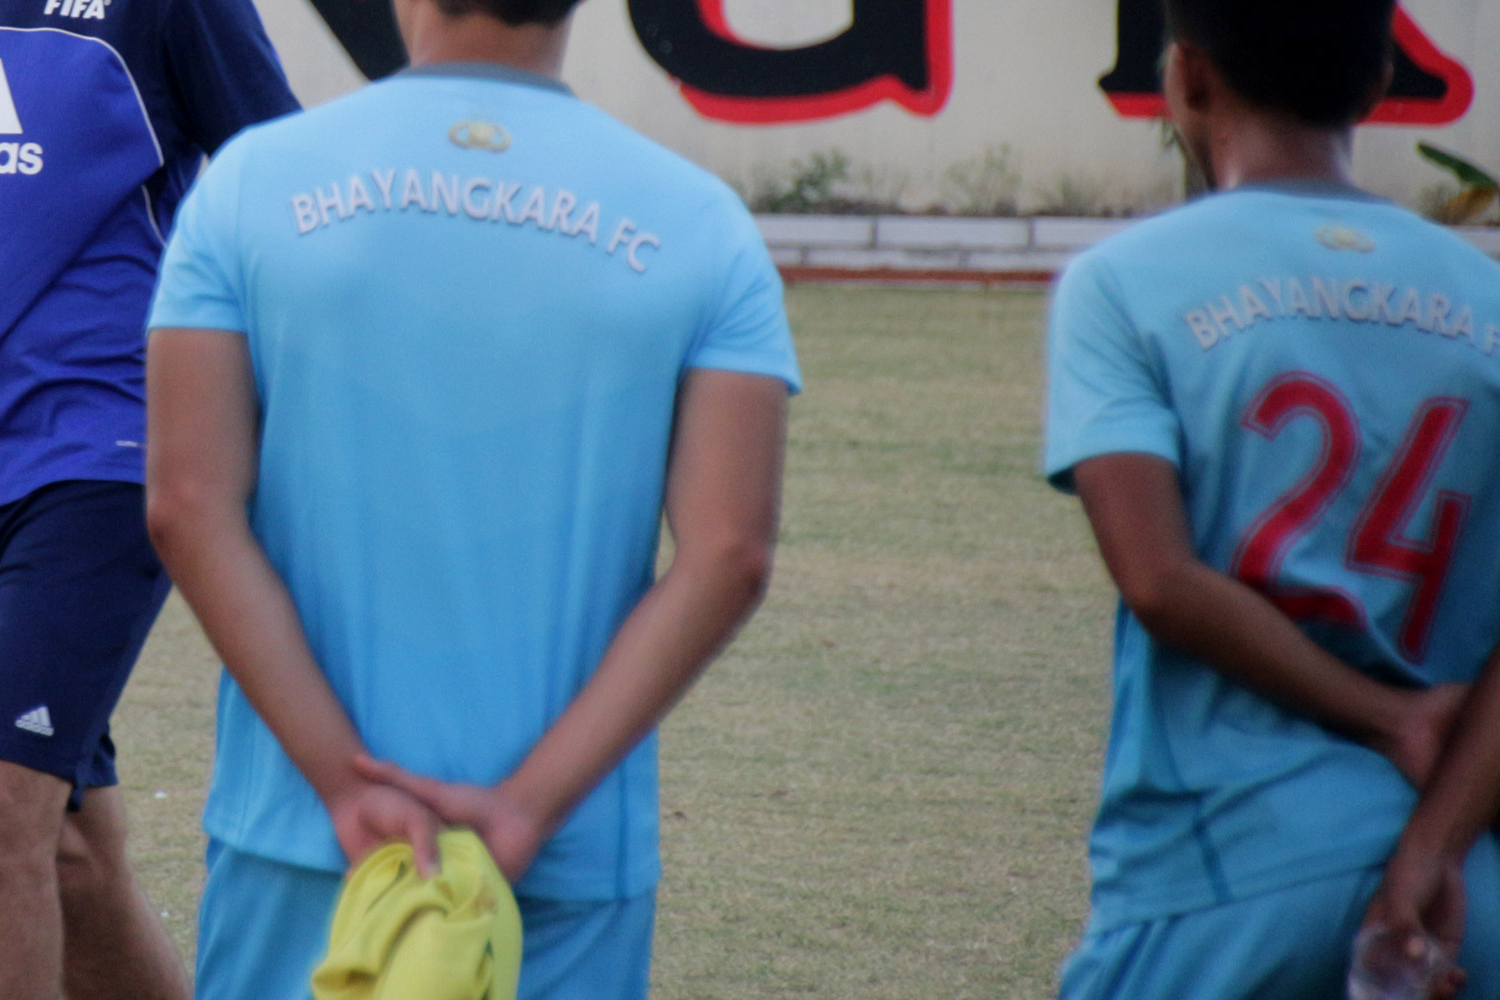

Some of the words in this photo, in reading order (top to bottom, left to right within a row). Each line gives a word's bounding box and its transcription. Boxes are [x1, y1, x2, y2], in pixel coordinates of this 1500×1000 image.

[291, 167, 601, 245] BHAYANGKARA
[605, 215, 661, 273] FC
[1185, 276, 1476, 352] BHAYANGKARA
[1228, 371, 1471, 664] 24
